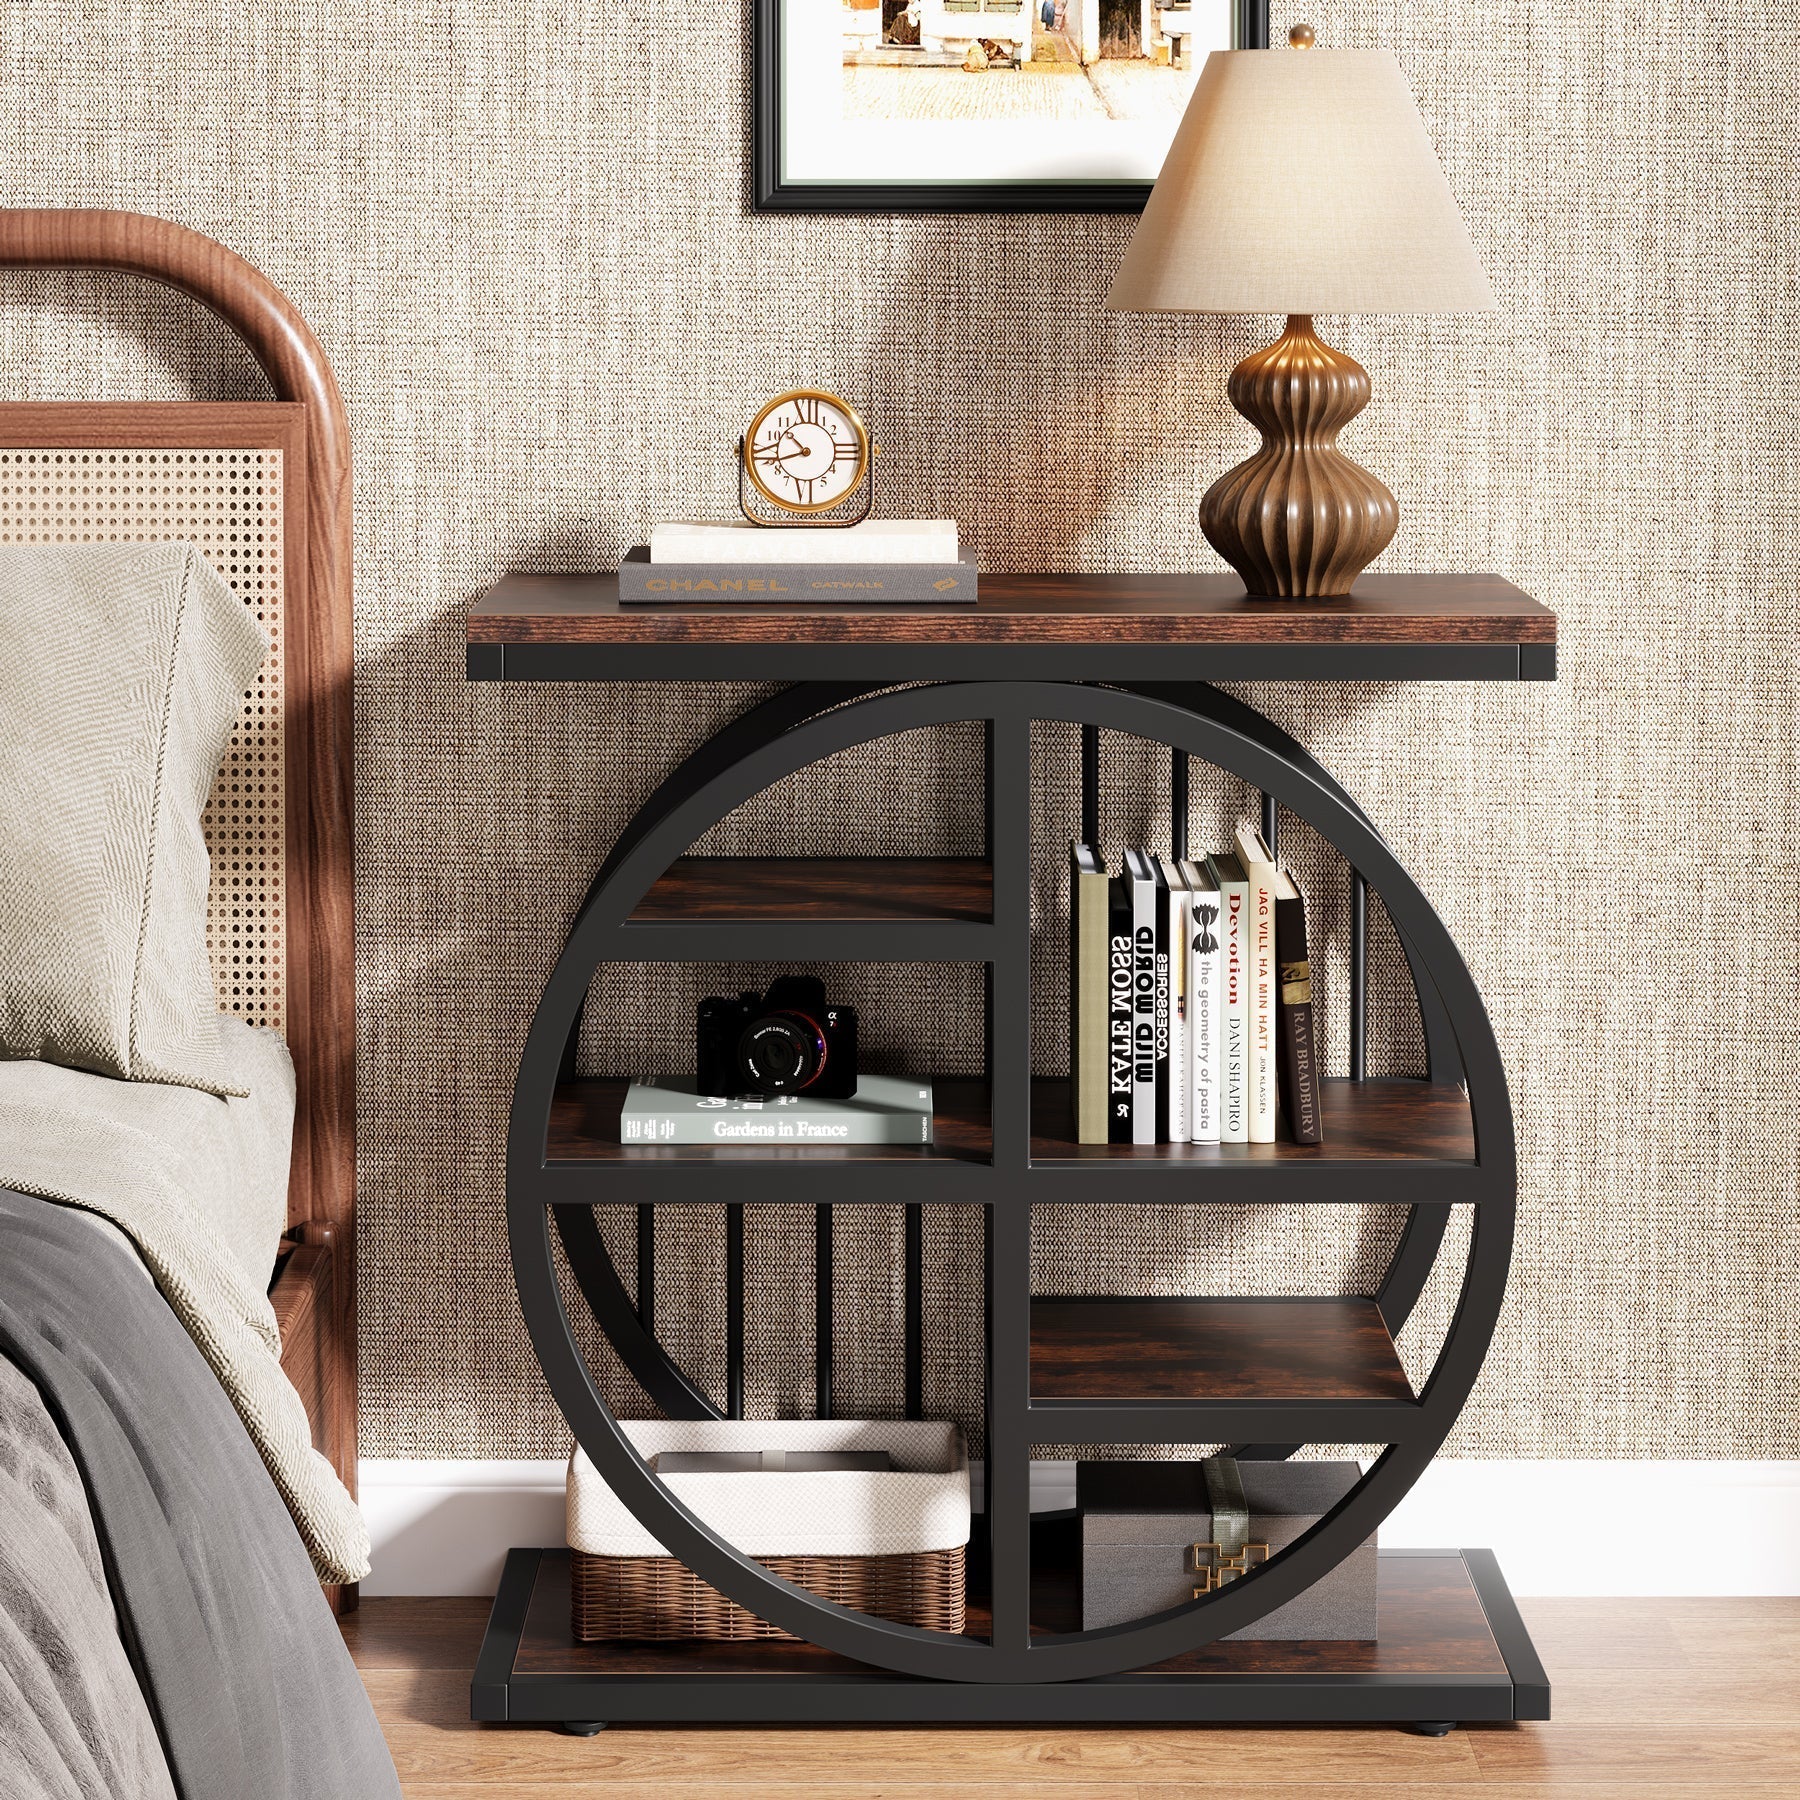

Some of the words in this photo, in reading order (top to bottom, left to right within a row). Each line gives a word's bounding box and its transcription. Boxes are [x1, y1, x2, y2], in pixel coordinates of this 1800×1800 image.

[778, 416, 790, 428] 11
[793, 399, 820, 425] XII
[821, 416, 827, 428] 1
[768, 430, 781, 441] 10
[830, 425, 837, 435] 2
[834, 443, 858, 461] III
[774, 465, 782, 476] 8
[829, 464, 837, 474] 4
[783, 476, 790, 487] 7
[820, 477, 827, 488] 5
[646, 579, 789, 592] CHANEL
[1259, 887, 1269, 916] JAG
[1259, 922, 1268, 951] VILL
[1229, 893, 1241, 1004] Devotion
[1200, 961, 1212, 985] the
[1259, 958, 1268, 977] HA
[1259, 983, 1268, 1009] MIN
[1198, 989, 1211, 1063] geometry
[1259, 1015, 1268, 1051] HATT
[1294, 1012, 1307, 1045] RAY
[1229, 1018, 1240, 1060] DANI
[1201, 1068, 1213, 1085] of
[1229, 1063, 1241, 1132] SHAPIRO
[1297, 1049, 1315, 1137] BRADBURY
[1198, 1088, 1211, 1130] pasta
[713, 1121, 776, 1137] Gardens
[778, 1121, 794, 1137] in
[797, 1121, 848, 1137] France
